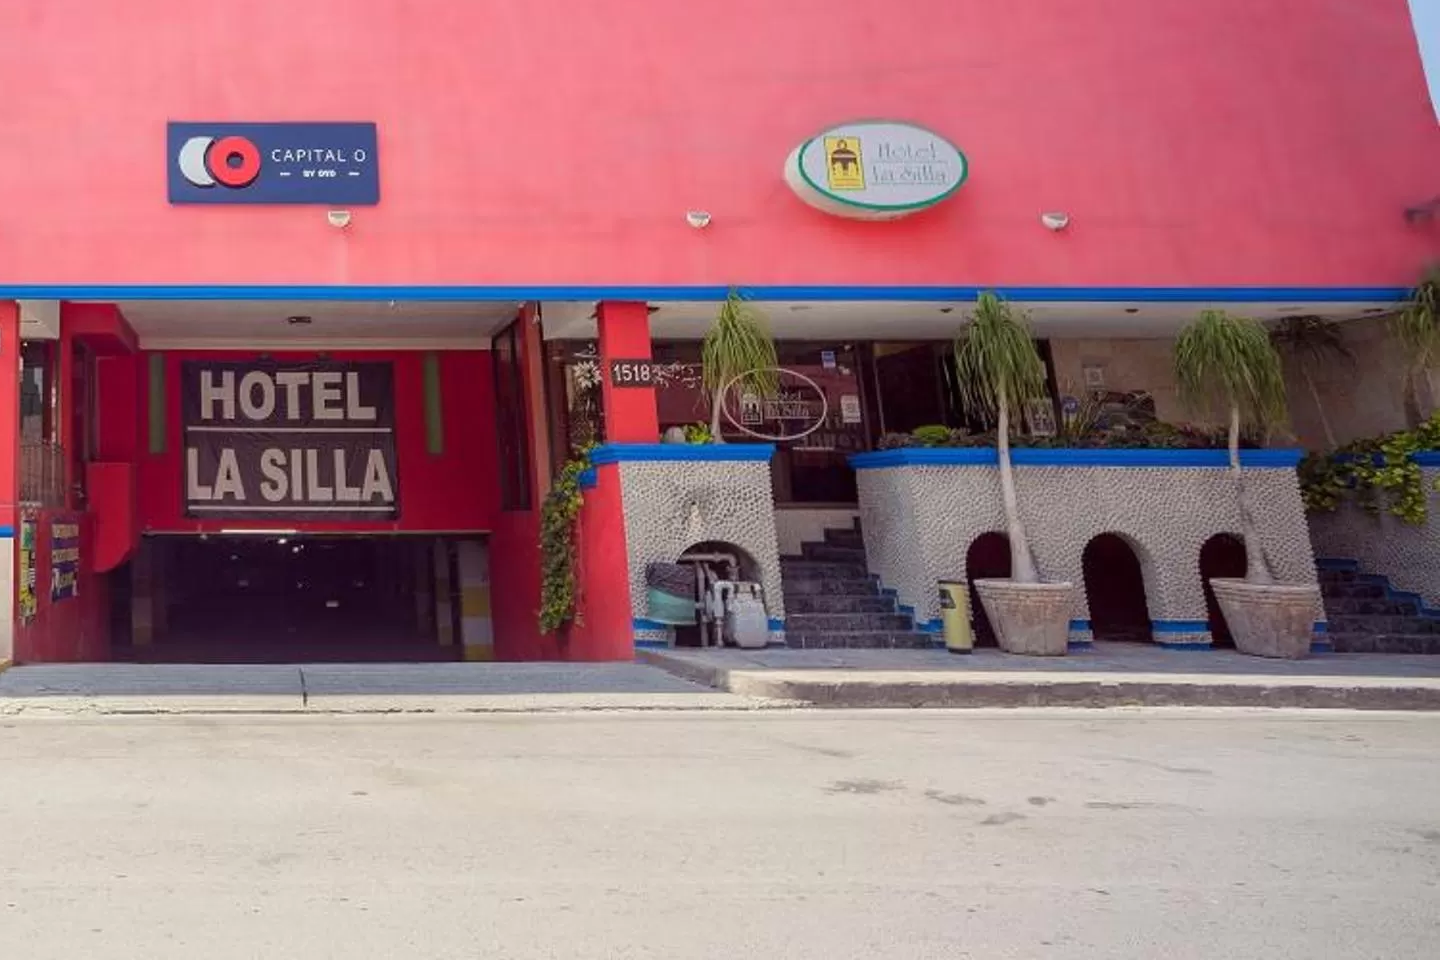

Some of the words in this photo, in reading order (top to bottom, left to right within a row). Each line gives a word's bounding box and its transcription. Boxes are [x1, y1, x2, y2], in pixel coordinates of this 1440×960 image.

[271, 148, 347, 162] CAPITAL
[355, 148, 366, 162] O
[877, 141, 937, 160] Hotel
[613, 363, 651, 382] 1518
[200, 370, 376, 420] HOTEL
[187, 447, 246, 501] LA
[260, 448, 394, 502] SILLA
